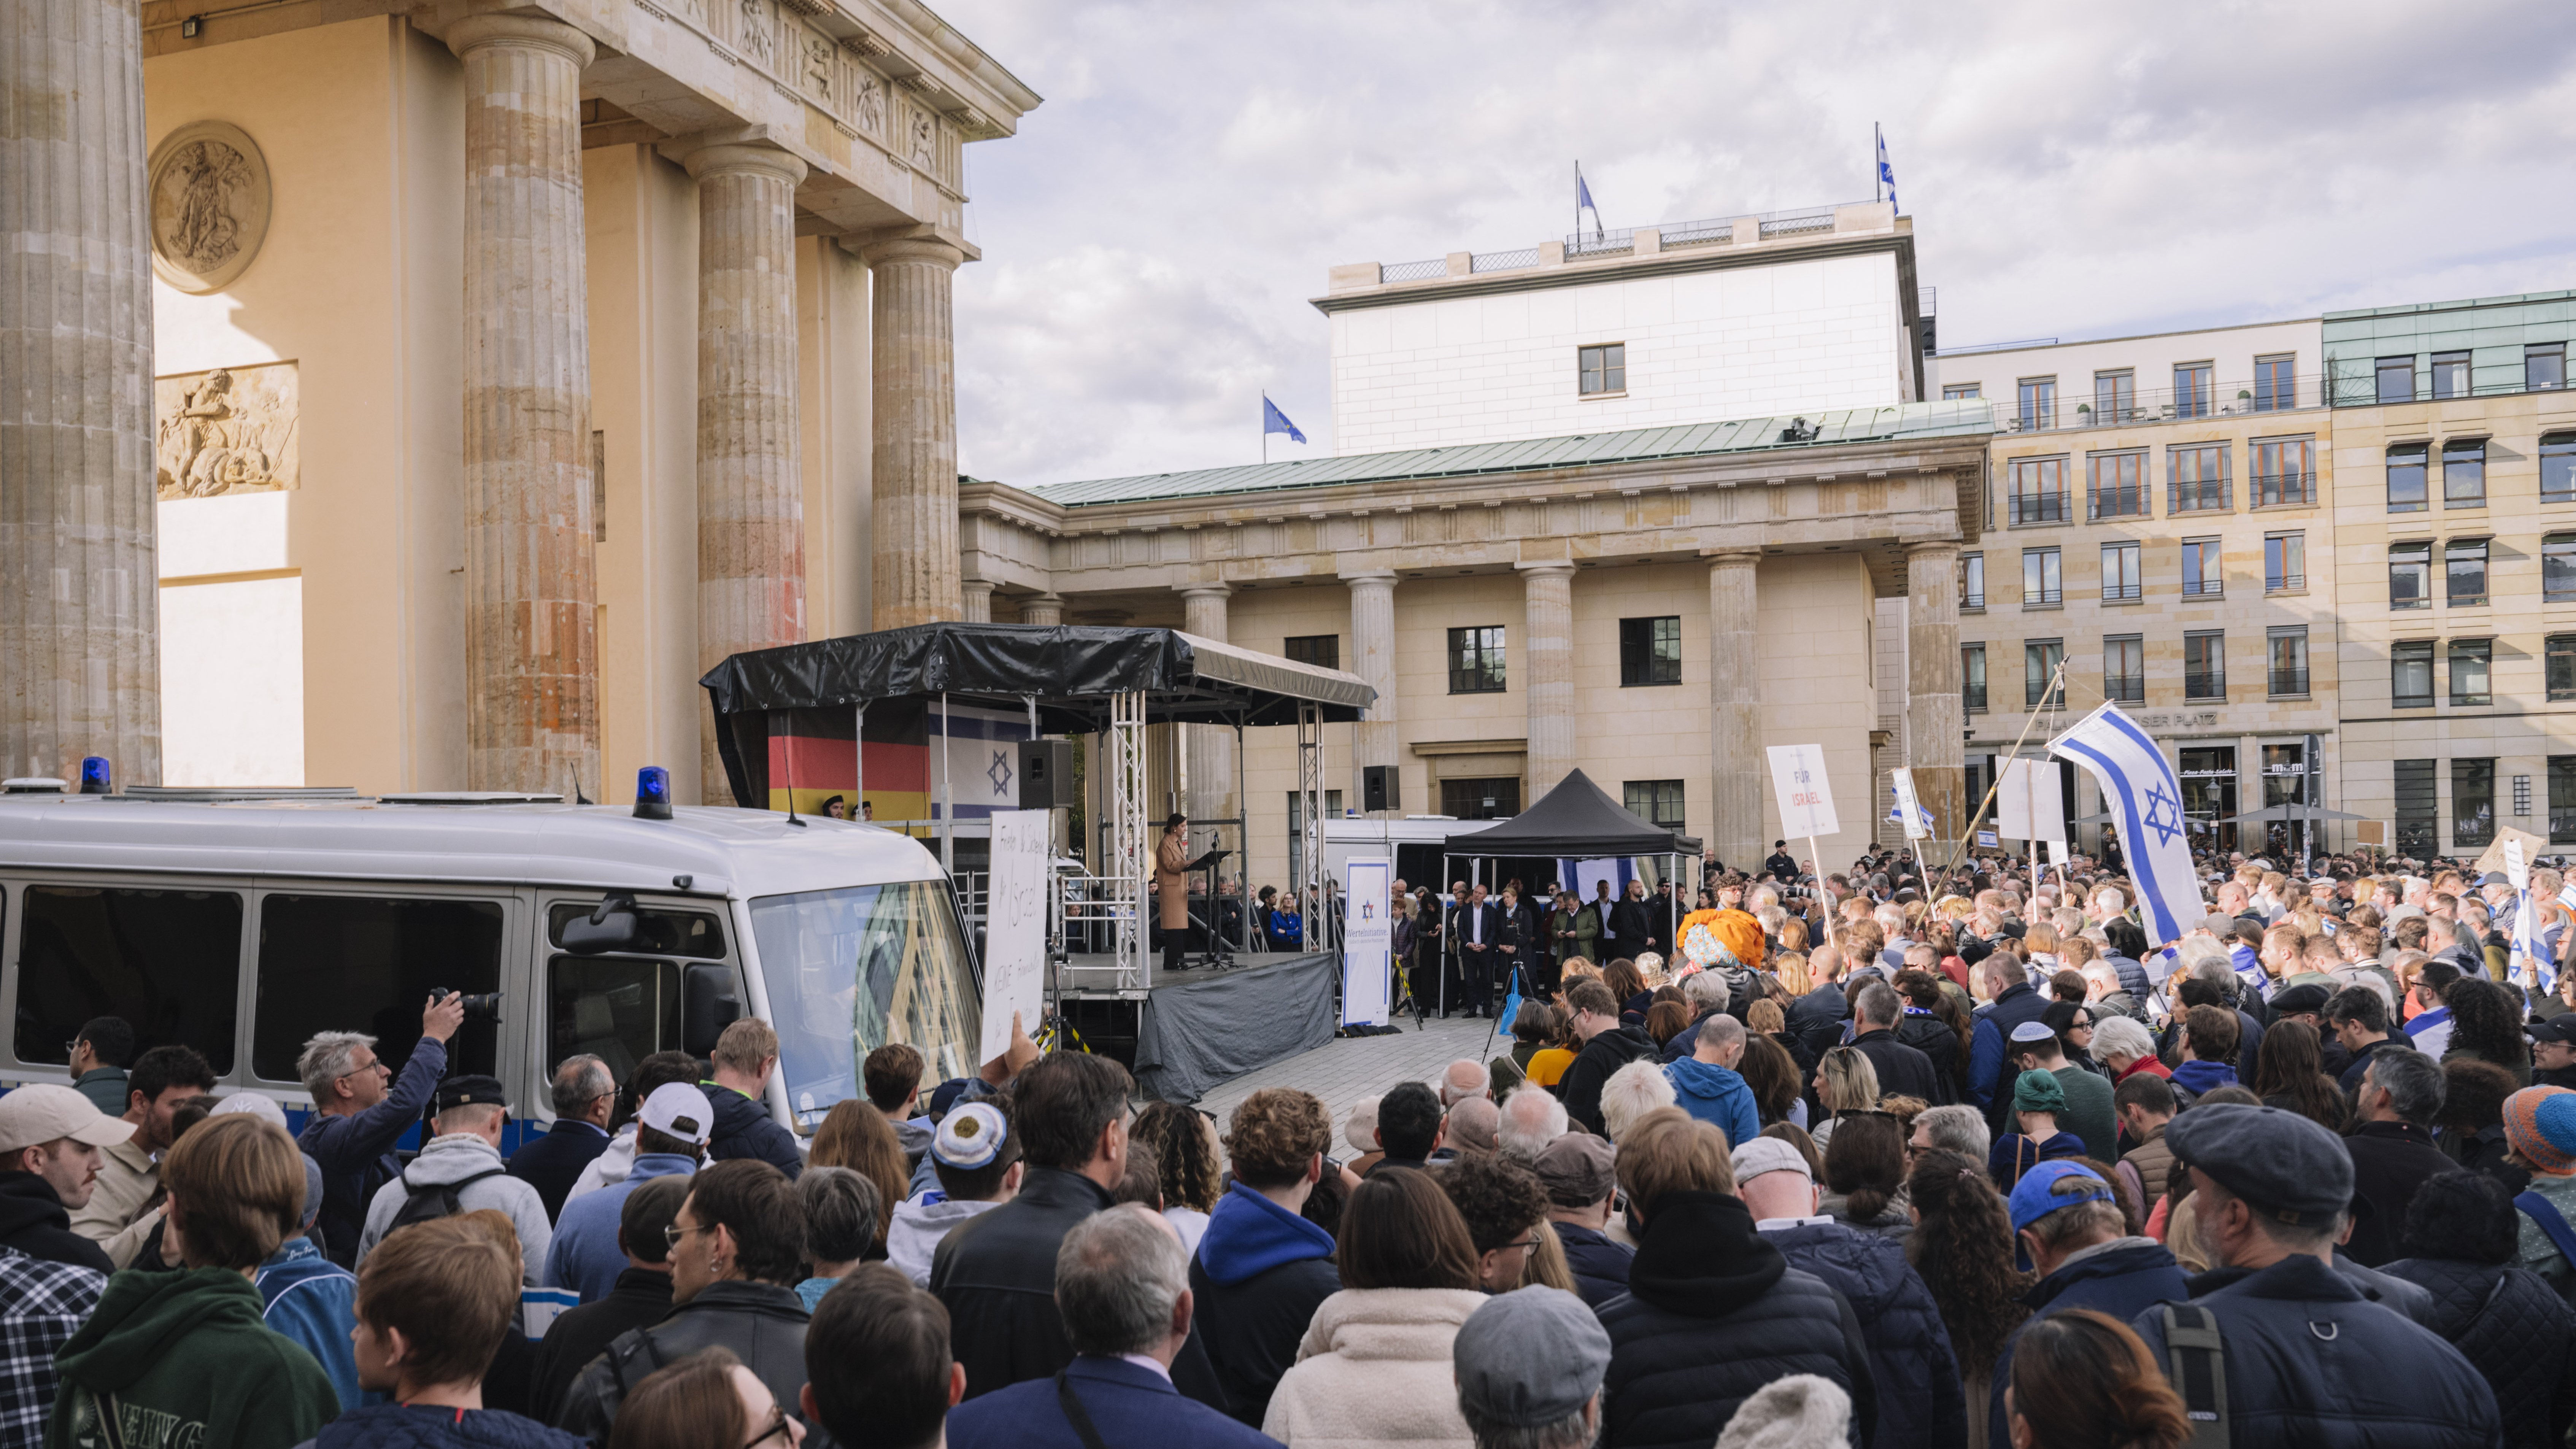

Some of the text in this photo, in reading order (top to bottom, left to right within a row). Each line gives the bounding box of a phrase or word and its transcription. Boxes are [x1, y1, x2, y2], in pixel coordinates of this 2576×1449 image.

[2174, 712, 2217, 726] PLATZ
[2271, 763, 2303, 772] mm
[1793, 768, 1811, 784] FÜR
[1791, 791, 1822, 807] ISRAEL.
